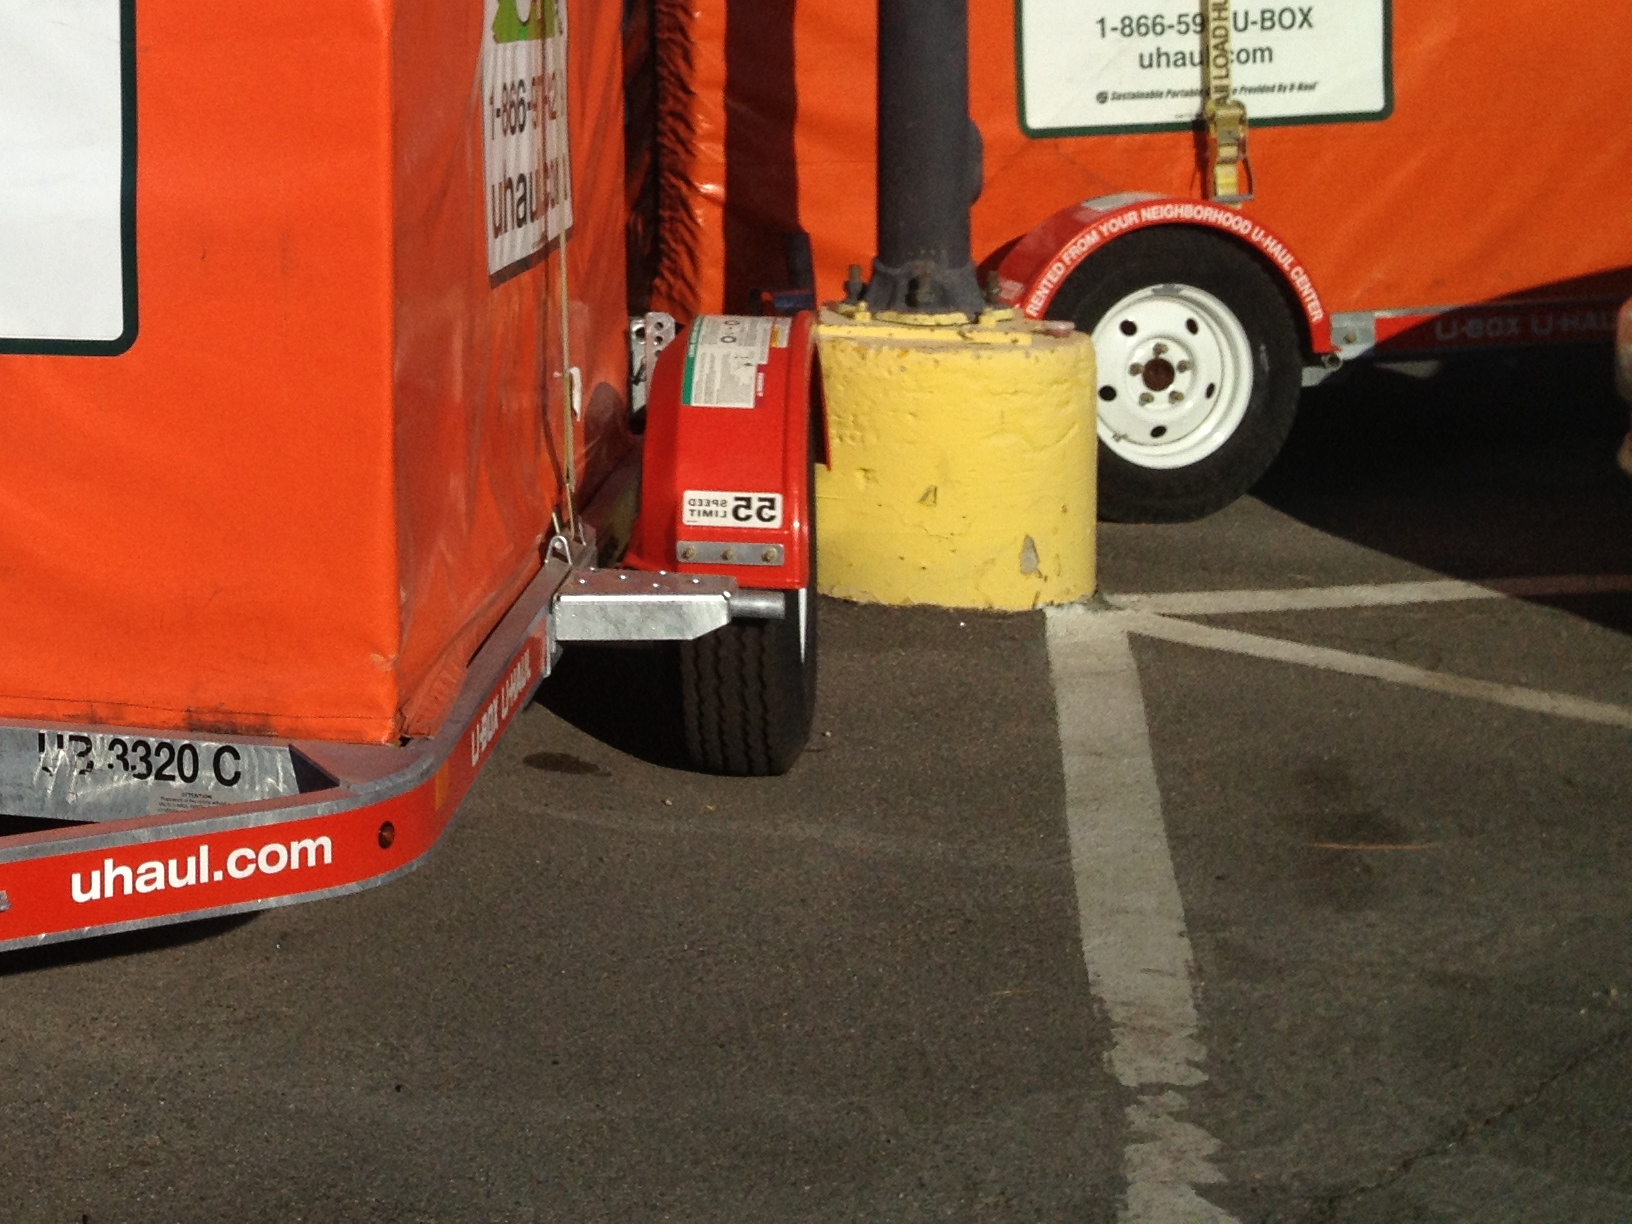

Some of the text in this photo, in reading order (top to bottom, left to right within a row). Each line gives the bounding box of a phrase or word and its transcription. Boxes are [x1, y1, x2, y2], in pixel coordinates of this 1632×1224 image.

[1210, 26, 1229, 81] LOAD
[1025, 203, 1326, 323] RENTED FROM YOUR NEIGHBORHOOD U-HAUL CENTER
[107, 738, 199, 784] 3320
[212, 744, 242, 787] C
[70, 834, 334, 905] uhaul.com
